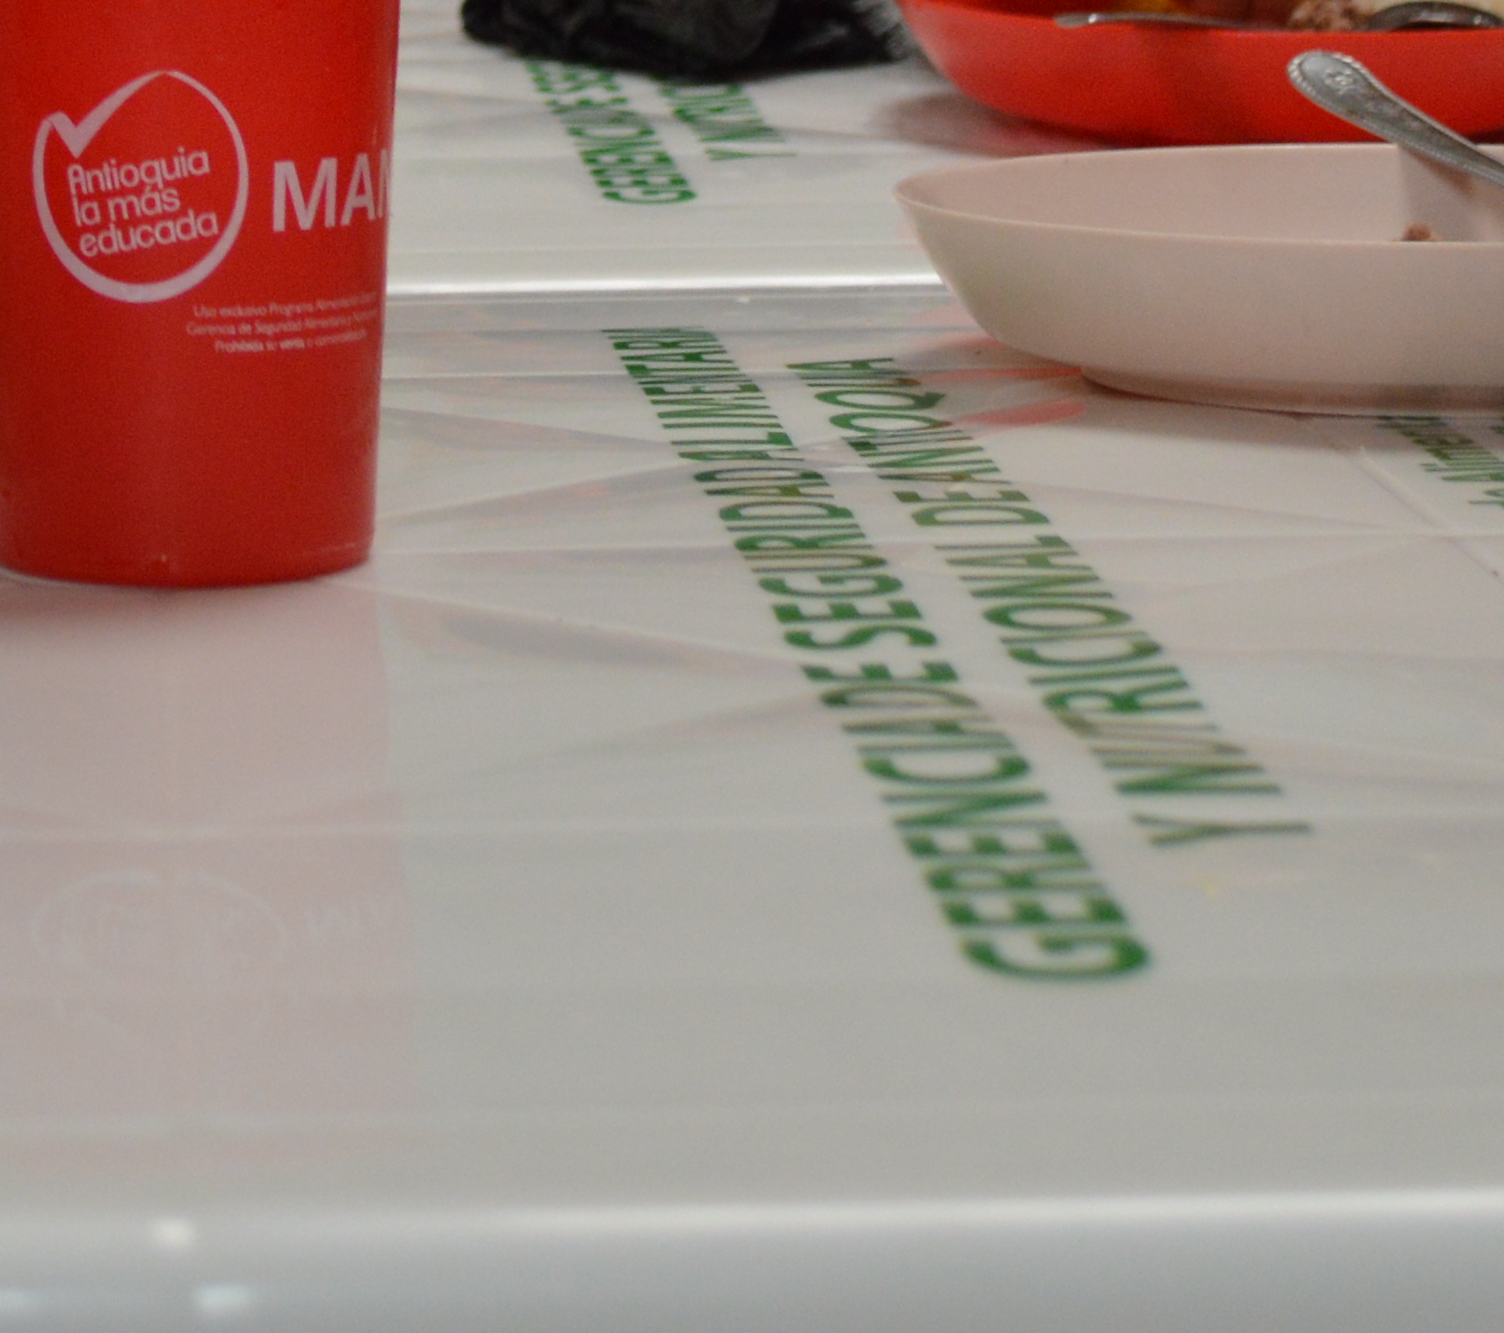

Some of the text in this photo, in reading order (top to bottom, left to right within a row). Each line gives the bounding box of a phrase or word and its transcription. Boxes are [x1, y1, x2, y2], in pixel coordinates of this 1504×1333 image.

[67, 146, 210, 196] Antioquia
[72, 184, 181, 227] la más
[79, 209, 219, 257] educada
[786, 357, 1314, 848] Y NUTRICIONAL DE ANTIOQUIA
[601, 326, 1149, 983] GERENCIA DE SEGURIDAD ALIMENTARIA
